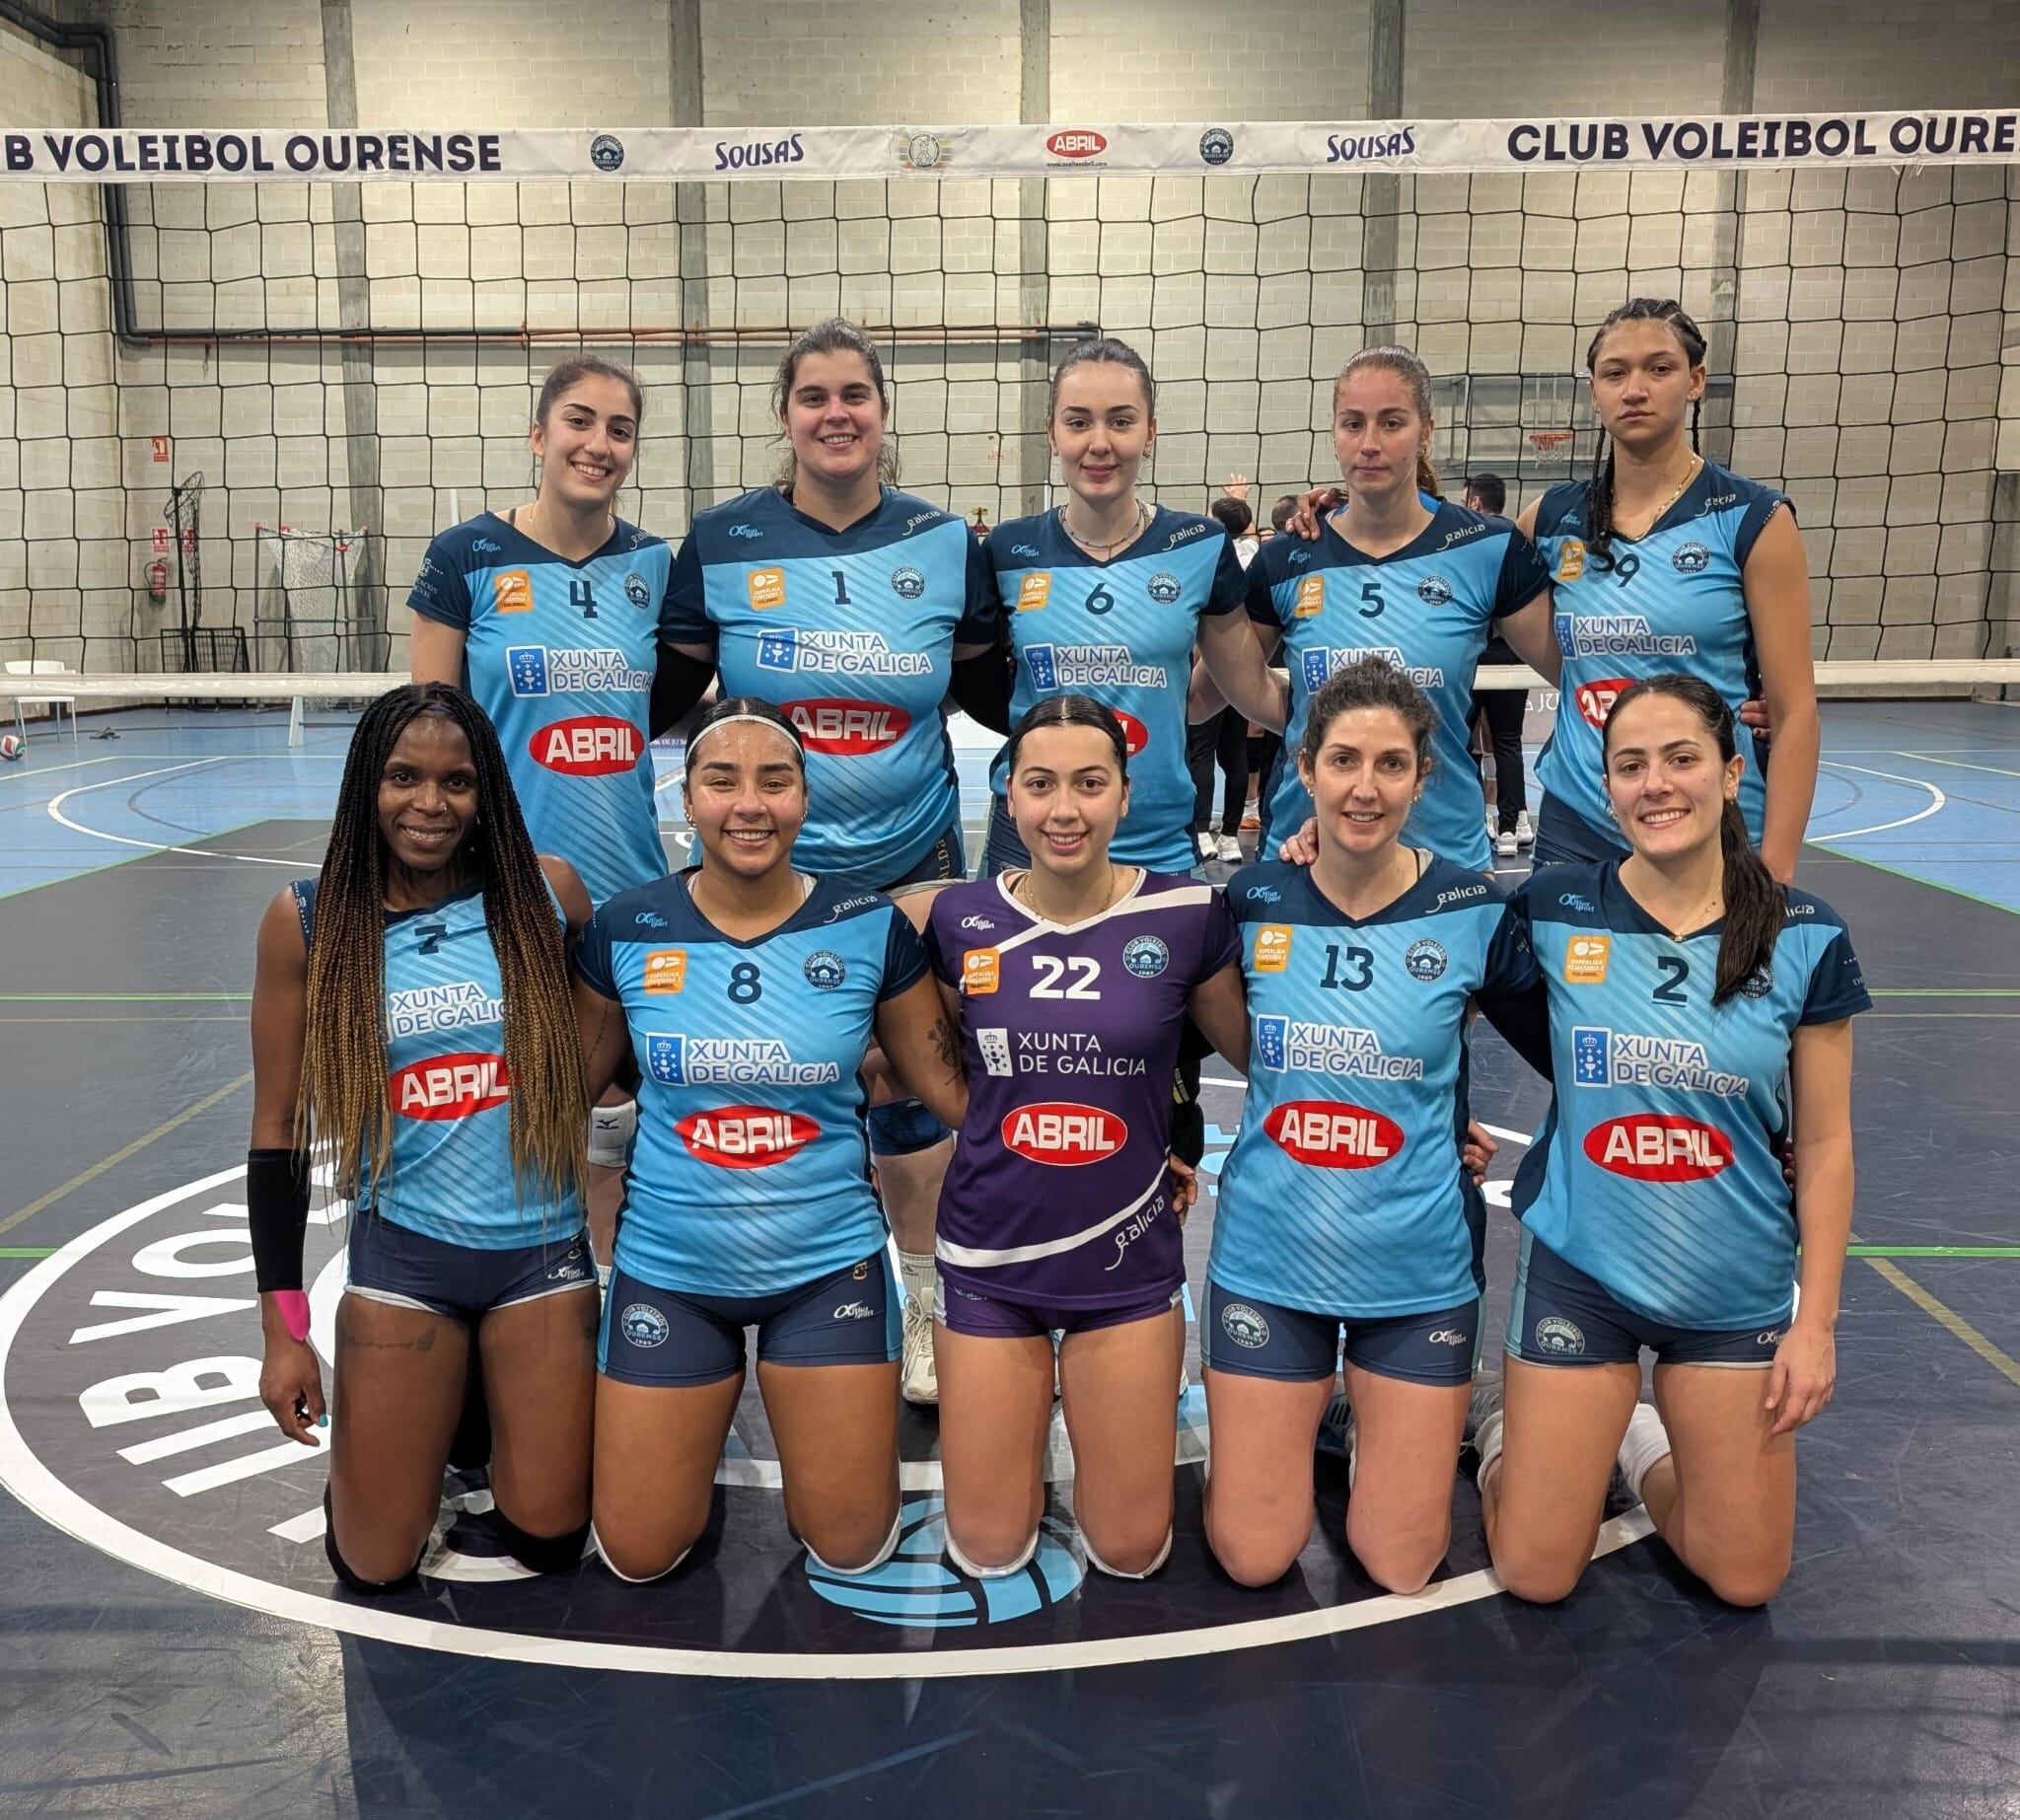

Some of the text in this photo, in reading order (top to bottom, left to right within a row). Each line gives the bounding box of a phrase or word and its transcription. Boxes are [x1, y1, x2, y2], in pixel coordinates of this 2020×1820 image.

[6, 134, 502, 172] B VOLEIBOL OURENSE
[715, 133, 804, 171] SOUSAS
[1053, 135, 1101, 151] ABRIL
[1327, 125, 1415, 162] SOUSAS
[1508, 114, 2018, 161] CLUB VOLEIBOL OURE
[902, 511, 940, 536] galicia
[1163, 524, 1206, 550] galicia
[1436, 524, 1484, 550] galicia
[1615, 553, 1639, 587] 9
[569, 581, 598, 618] 4
[831, 571, 851, 605] 1
[1086, 583, 1114, 615] 6
[1359, 583, 1385, 618] 5
[1577, 618, 1649, 634] XUNTA
[803, 634, 885, 650] XUNTA
[1059, 647, 1129, 664] XUNTA
[1580, 637, 1695, 654] DE GALICIA
[554, 651, 626, 669] XUNTA
[804, 655, 932, 673] DE GALICIA
[554, 671, 652, 691] DE GALICIA
[1062, 667, 1166, 687] DE GALICIA
[791, 706, 897, 740] ABRIL
[545, 728, 635, 763] ABRIL
[824, 895, 878, 923] galicia
[1425, 884, 1487, 913] galicia
[1785, 903, 1816, 918] licia
[414, 924, 448, 955] 7
[727, 962, 762, 1005] 8
[1030, 955, 1101, 1000] 22
[1320, 944, 1374, 992] 13
[1652, 956, 1690, 1002] 2
[393, 983, 483, 1011] XUNTA
[396, 998, 505, 1035] DE GALIC
[692, 1042, 787, 1060] XUNTA
[1018, 1033, 1102, 1053] XUNTA
[1293, 1024, 1379, 1051] XUNTA
[1618, 1039, 1706, 1066] XUNTA
[693, 1062, 837, 1083] DE GALICIA
[1019, 1056, 1146, 1075] DE GALICIA
[1294, 1051, 1422, 1078] DE GALICIA
[1618, 1063, 1747, 1097] DE GALICIA
[401, 1061, 509, 1110] ABRIL
[692, 1116, 806, 1154] ABRIL
[1012, 1114, 1115, 1151] ABRIL
[1279, 1109, 1388, 1157] ABRIL
[1603, 1126, 1724, 1168] ABRIL
[1105, 1195, 1165, 1271] galicia
